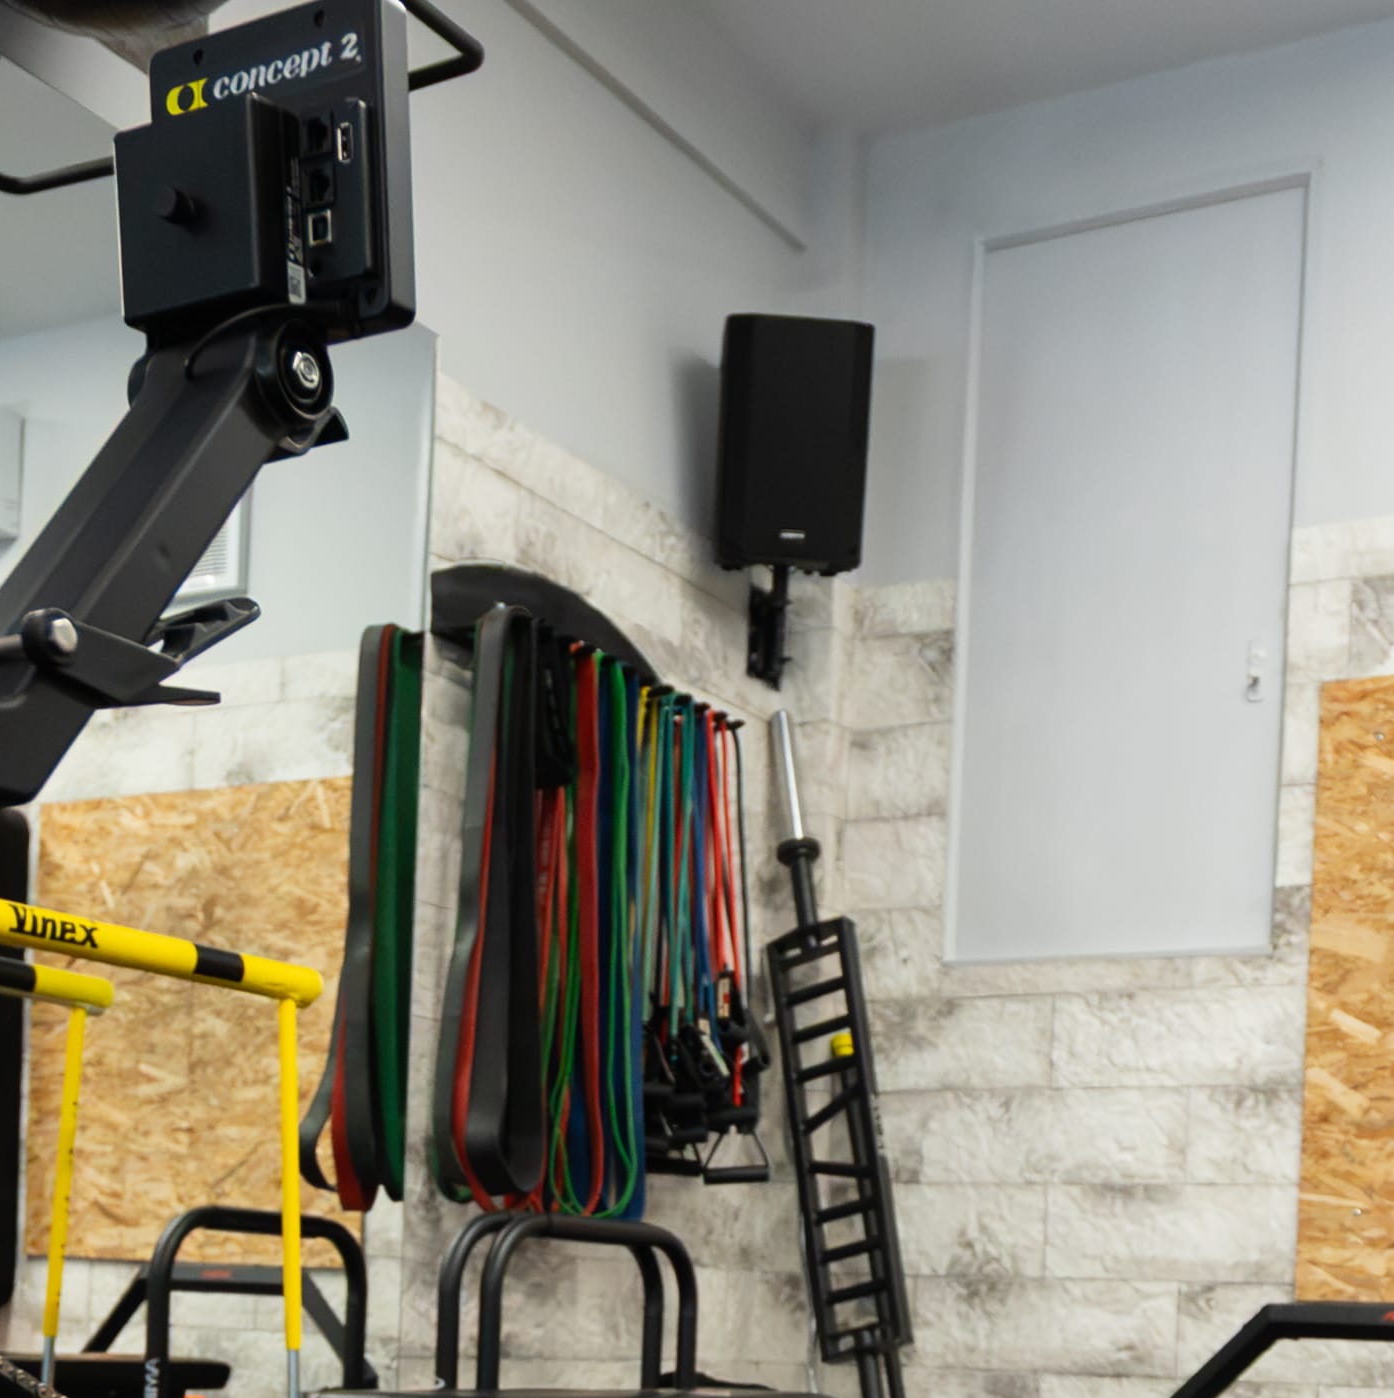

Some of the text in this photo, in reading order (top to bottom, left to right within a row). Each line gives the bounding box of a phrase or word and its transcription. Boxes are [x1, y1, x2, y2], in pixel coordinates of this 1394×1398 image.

[213, 32, 358, 100] concept 2
[8, 904, 98, 949] Vinex
